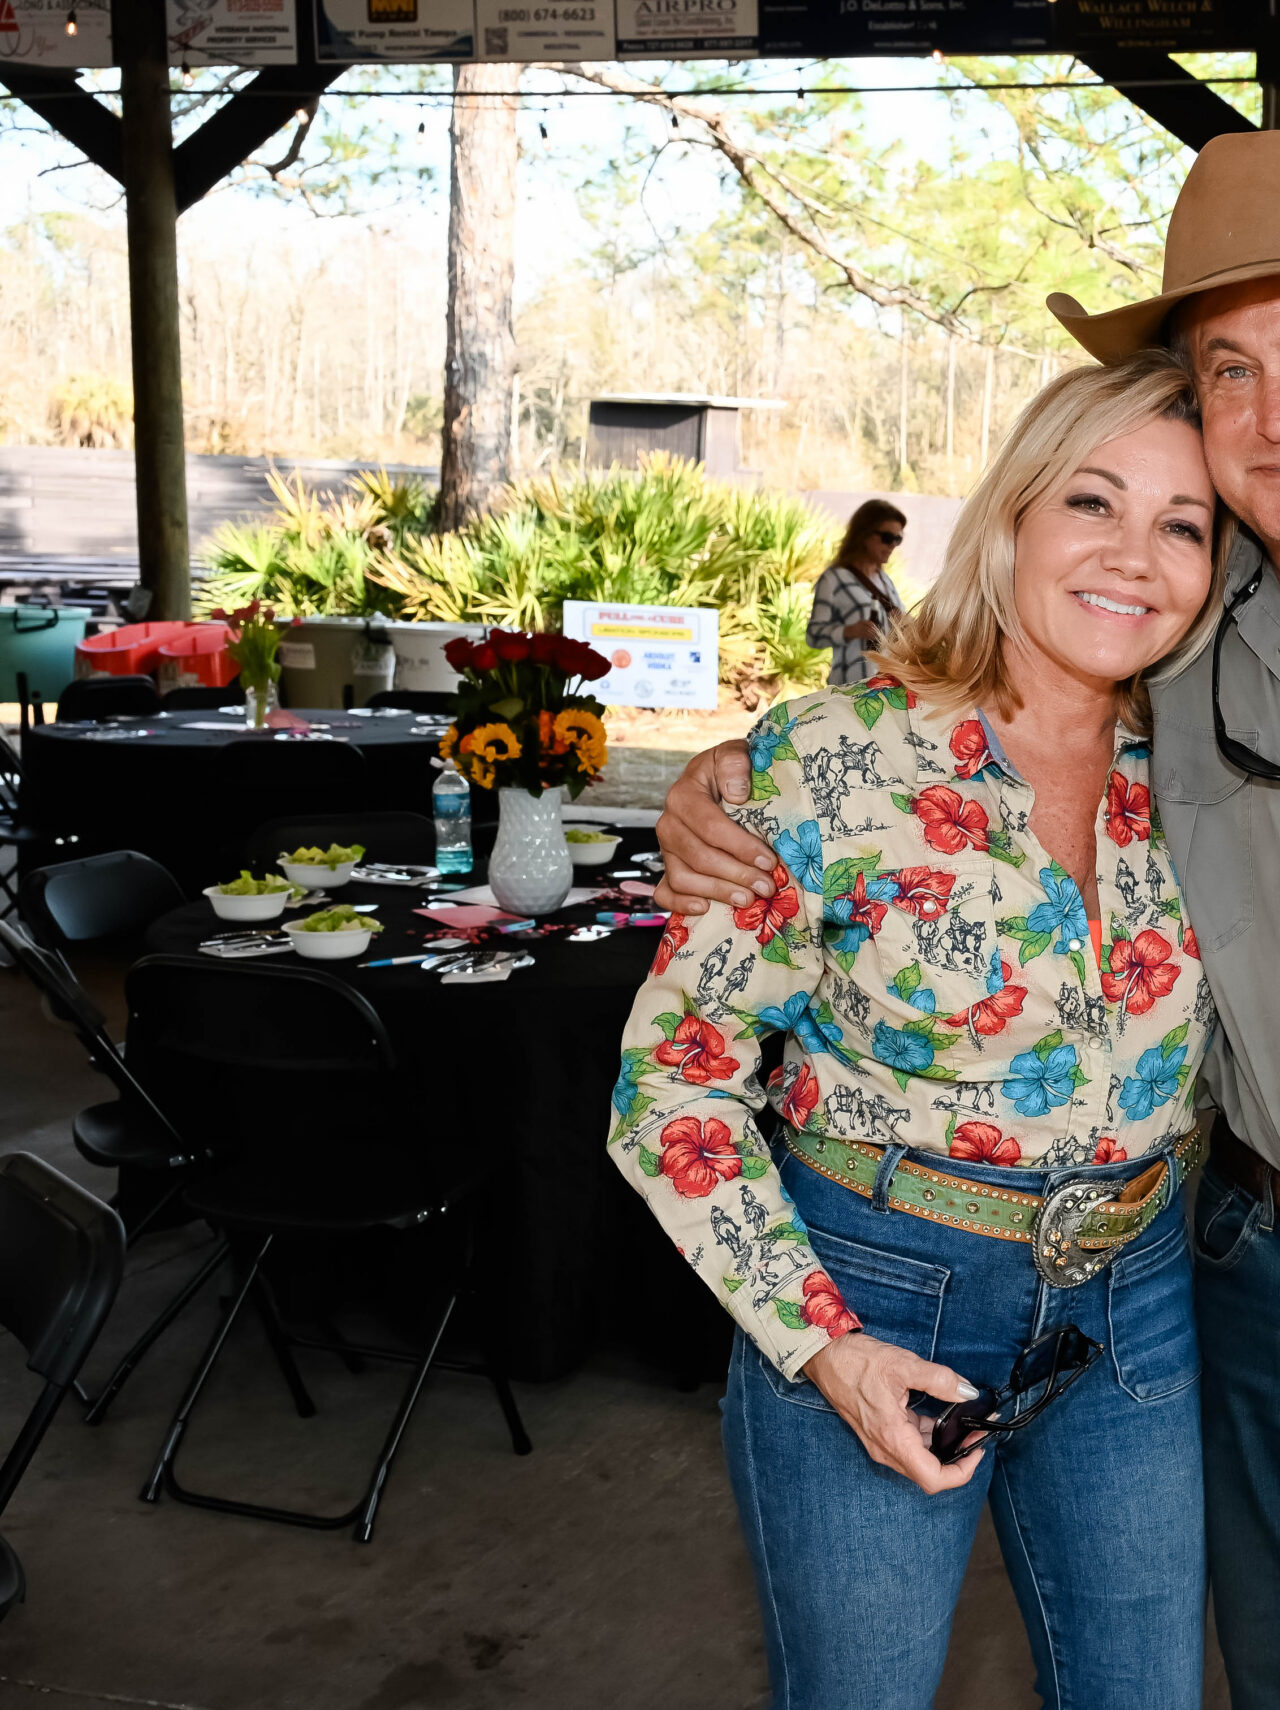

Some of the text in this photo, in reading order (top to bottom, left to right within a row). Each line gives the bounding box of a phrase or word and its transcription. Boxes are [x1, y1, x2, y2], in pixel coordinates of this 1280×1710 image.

[636, 0, 737, 13] AIRPRO
[498, 8, 596, 23] (800) 674-6623
